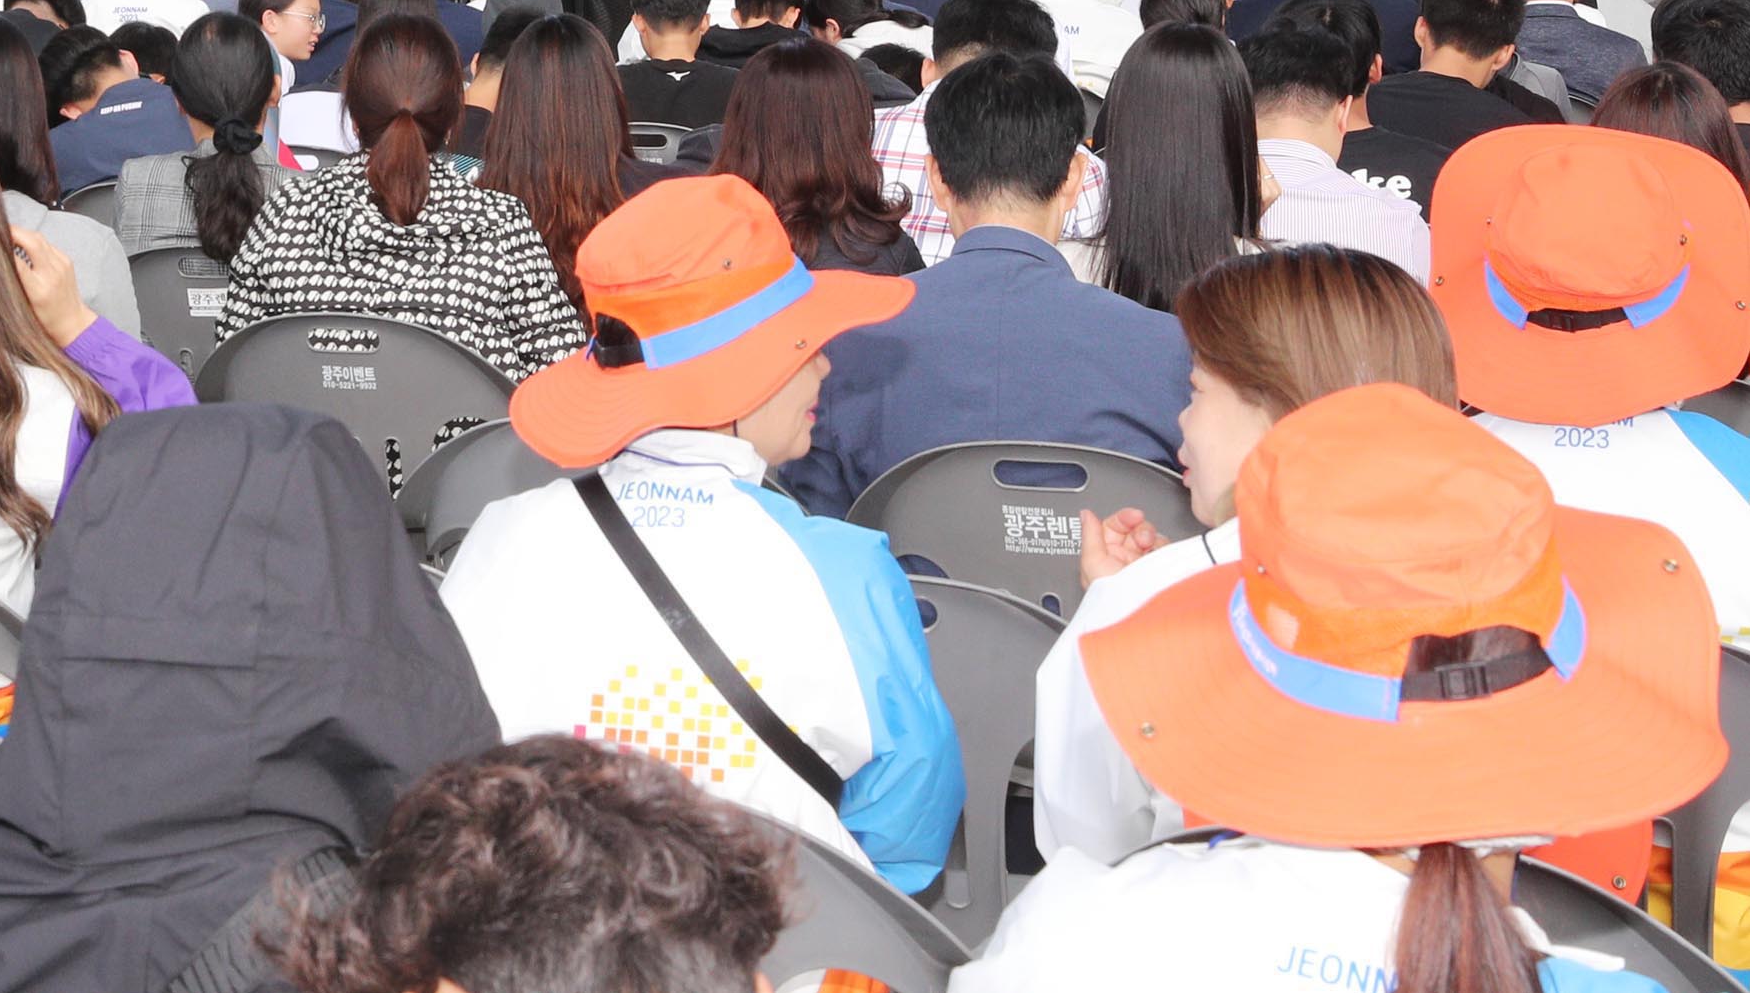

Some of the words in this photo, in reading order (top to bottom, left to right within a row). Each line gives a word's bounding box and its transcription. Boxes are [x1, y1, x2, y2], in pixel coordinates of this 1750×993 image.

[321, 365, 377, 382] 광주이벤트
[1554, 427, 1610, 448] 2023
[616, 481, 714, 504] JEONNAM
[632, 505, 686, 527] 2023
[1277, 946, 1399, 993] JEONN
